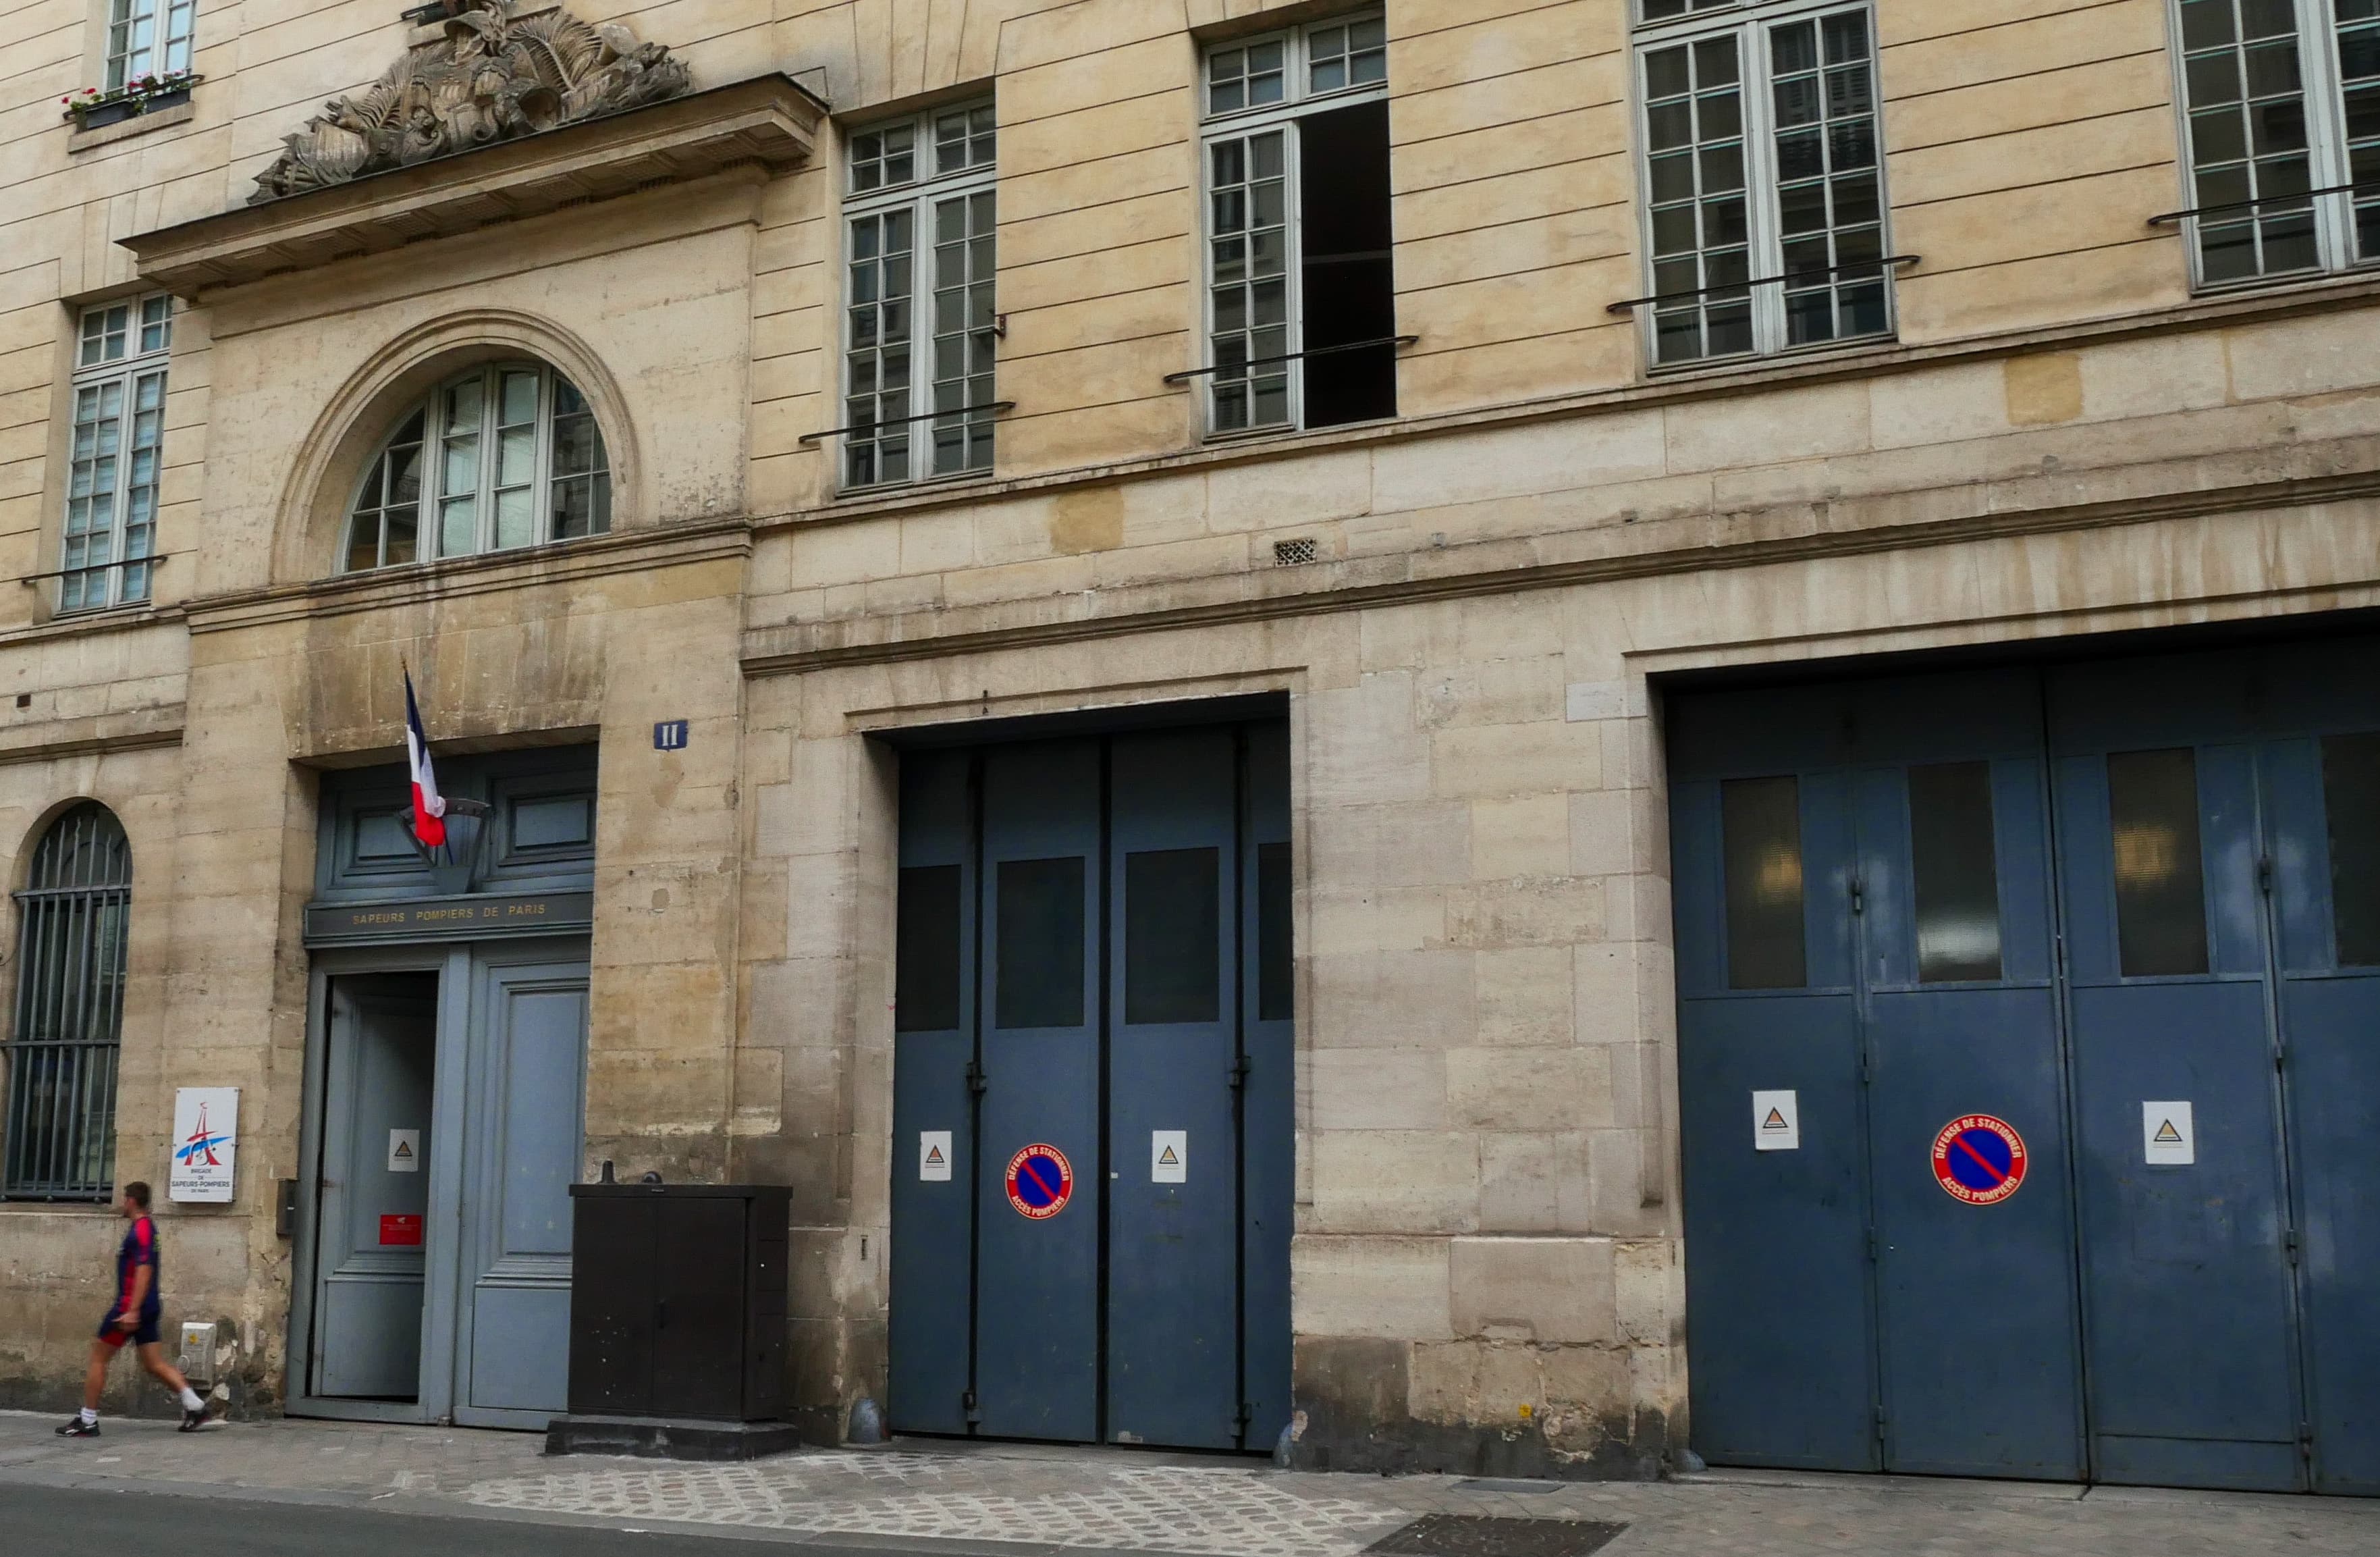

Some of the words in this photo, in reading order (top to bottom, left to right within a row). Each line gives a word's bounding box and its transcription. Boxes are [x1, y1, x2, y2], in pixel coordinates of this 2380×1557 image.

[353, 912, 405, 924] SAPEURS
[415, 907, 474, 920] POMPIERS
[483, 907, 499, 917] DE
[508, 904, 545, 915] PARIS
[1935, 1123, 1962, 1159] DÉFENSE
[1962, 1119, 1976, 1129] DE
[1977, 1117, 2023, 1159] STATIONNER
[1028, 1146, 1039, 1156] DE
[1039, 1146, 1070, 1182] STATIONNER
[1942, 1177, 1971, 1199] ACCÈS
[1972, 1176, 2018, 1201] POMPIERS
[1012, 1195, 1031, 1214] ACCÈS
[1031, 1195, 1065, 1216] POMPIERS
